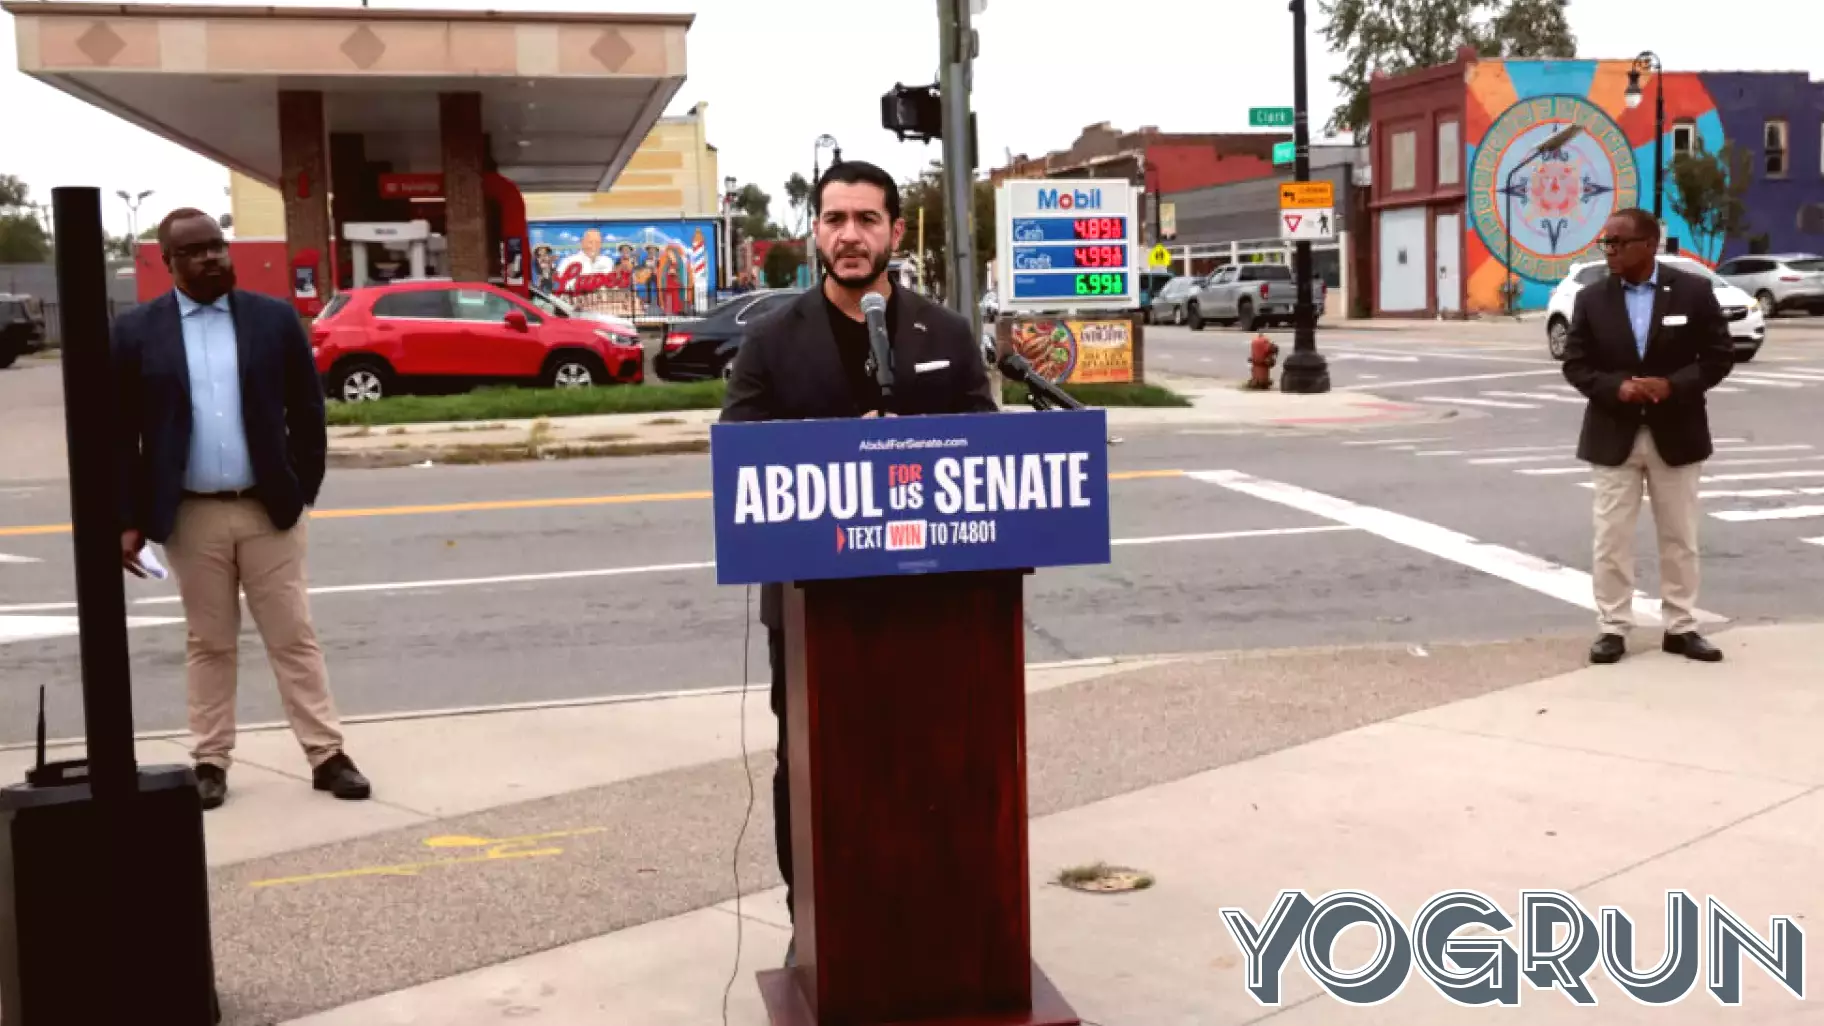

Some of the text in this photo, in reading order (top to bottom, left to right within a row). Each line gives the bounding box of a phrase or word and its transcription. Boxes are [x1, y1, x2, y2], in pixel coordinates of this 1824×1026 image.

[1256, 109, 1286, 124] Clark
[1037, 188, 1102, 210] Mobil
[1015, 225, 1044, 241] Cash
[1015, 252, 1052, 269] Credit
[858, 437, 969, 452] AbdulForSenate.com
[734, 451, 1091, 525] ABDUL FOR US SENATE
[846, 520, 997, 550] TEXT WIN TO 74801
